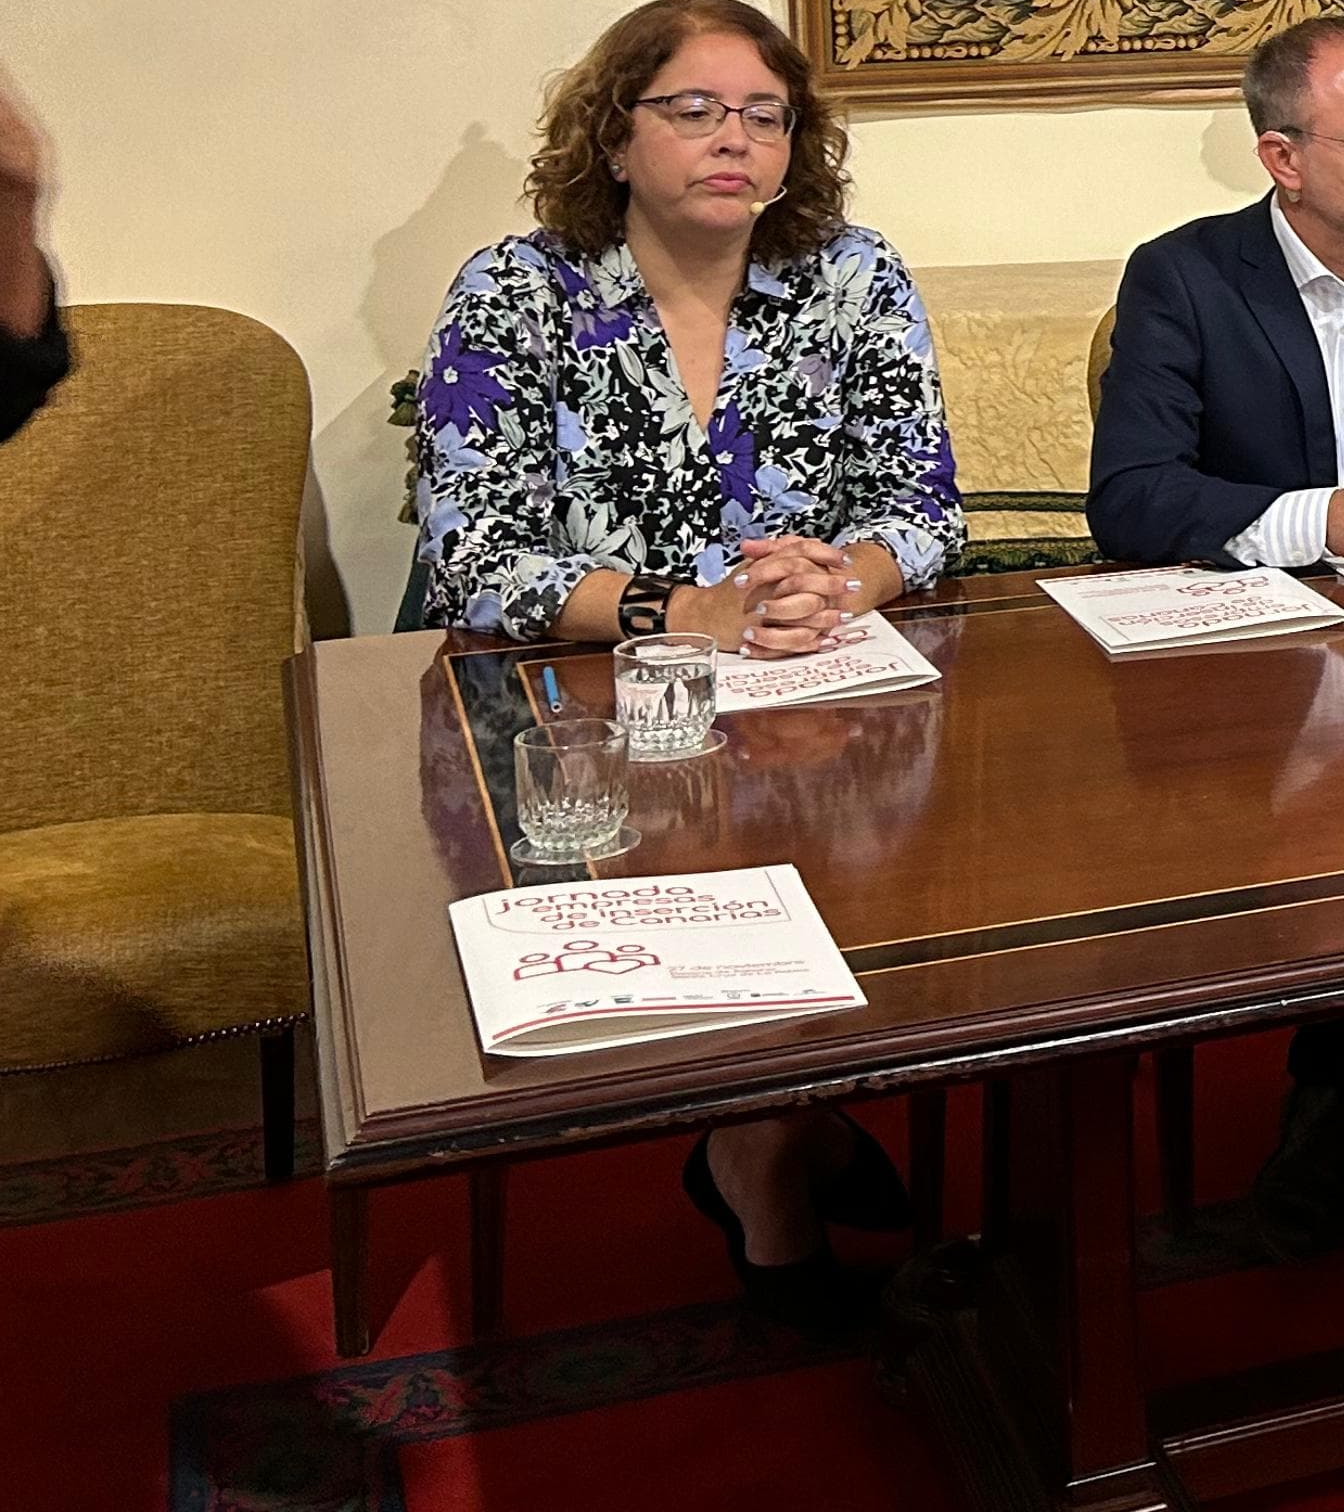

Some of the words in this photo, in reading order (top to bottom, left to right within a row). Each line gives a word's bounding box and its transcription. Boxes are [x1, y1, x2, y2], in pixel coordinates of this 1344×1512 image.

[724, 664, 810, 681] Canar
[749, 662, 899, 698] jornada
[496, 885, 694, 915] jornada
[532, 894, 716, 913] empresas
[540, 910, 588, 923] de
[599, 899, 769, 919] inserción
[551, 919, 600, 931] de
[609, 906, 782, 926] Canarias
